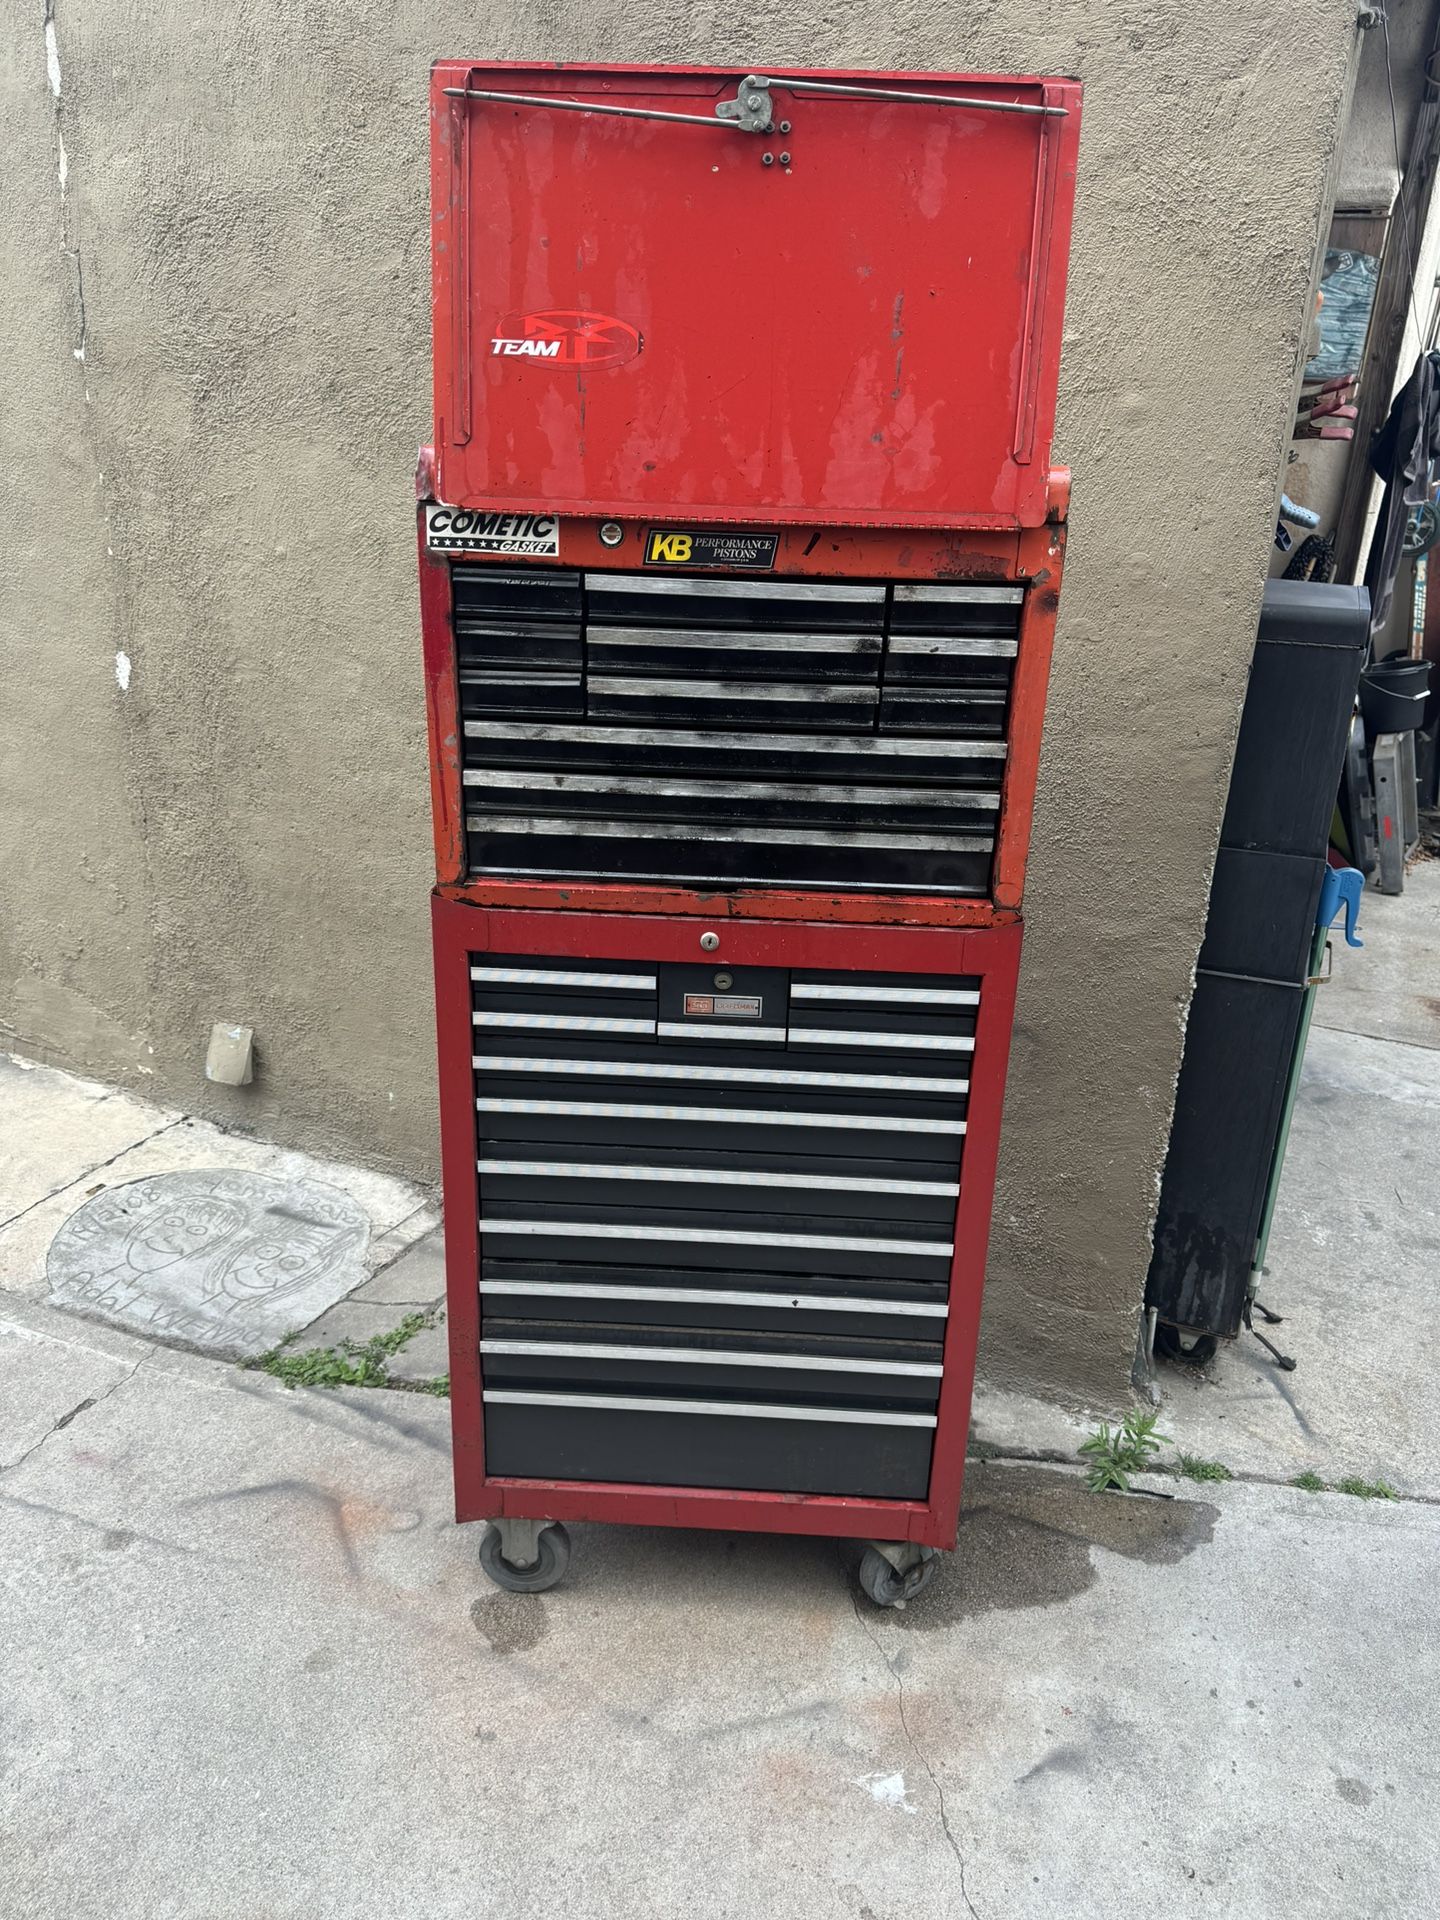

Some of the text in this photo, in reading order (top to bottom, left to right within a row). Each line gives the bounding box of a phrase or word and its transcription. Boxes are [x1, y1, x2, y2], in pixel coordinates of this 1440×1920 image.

[490, 338, 563, 357] TEAM
[429, 510, 555, 538] COMETIC
[499, 540, 553, 553] GASKET
[651, 534, 693, 561] KB
[694, 537, 773, 550] PERFORMANCE
[713, 548, 758, 559] PISTONS
